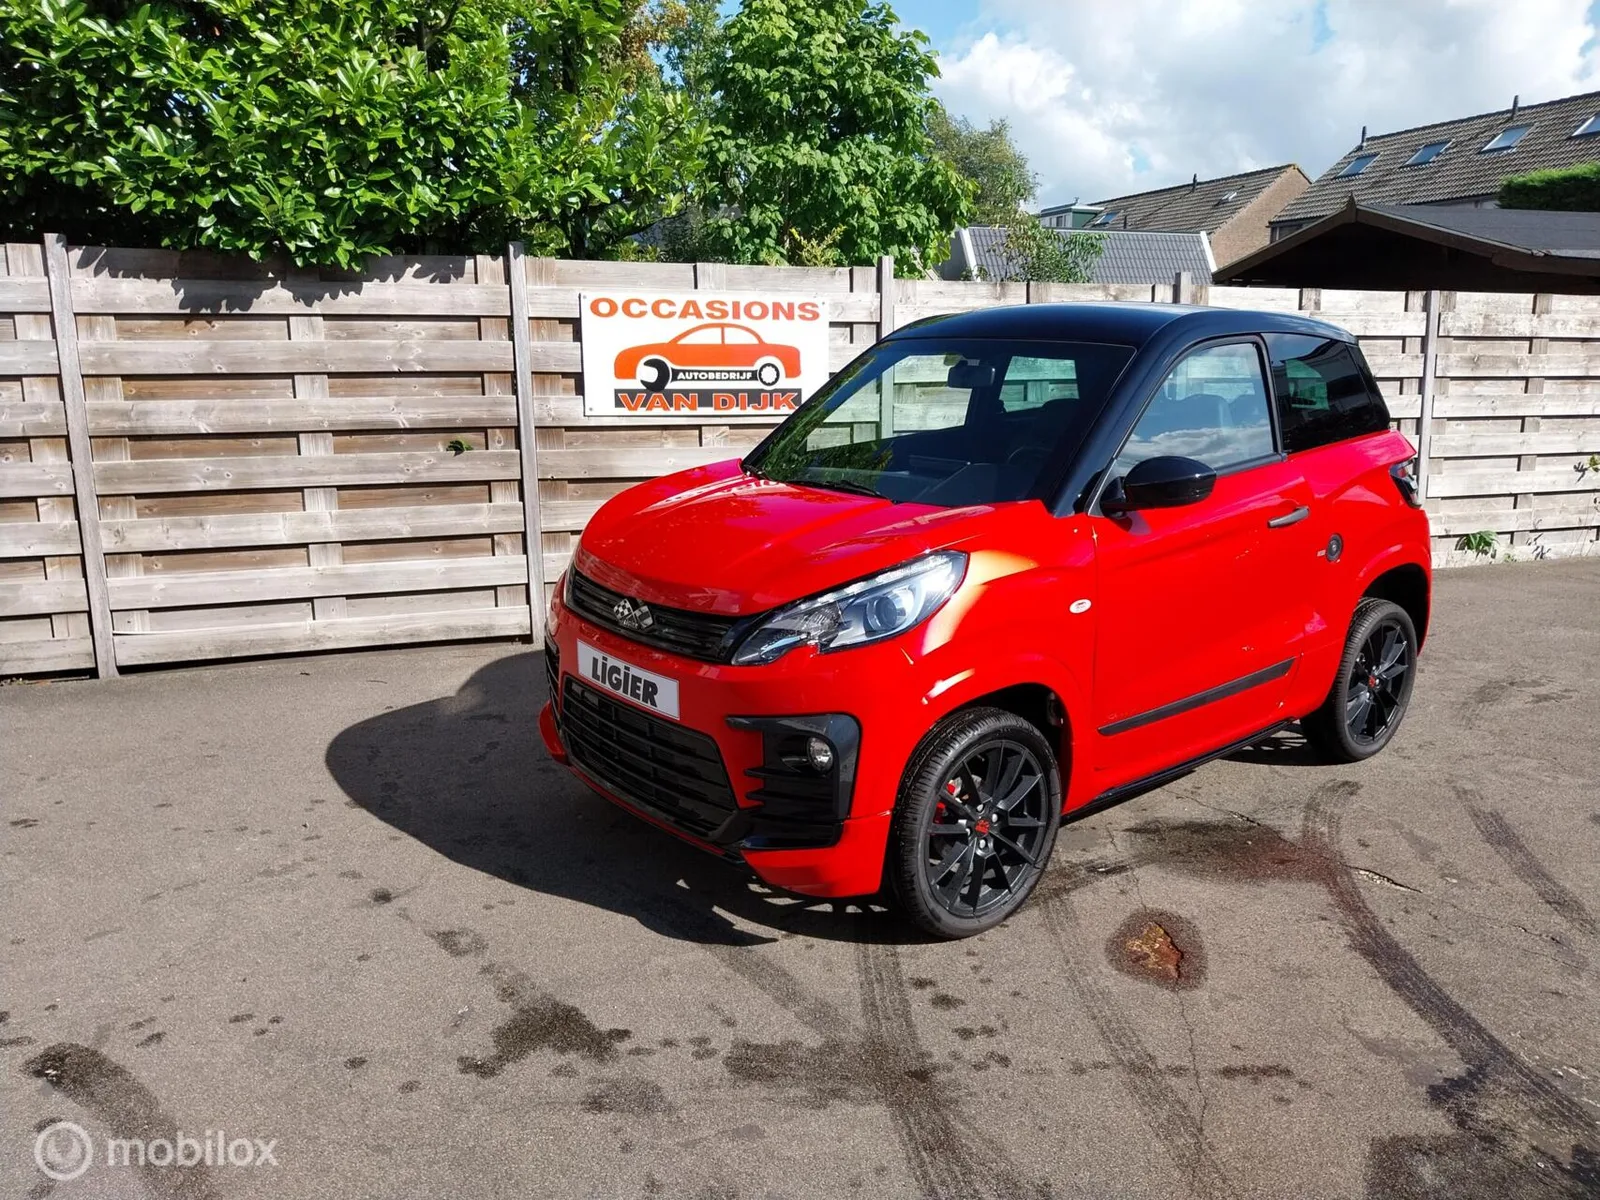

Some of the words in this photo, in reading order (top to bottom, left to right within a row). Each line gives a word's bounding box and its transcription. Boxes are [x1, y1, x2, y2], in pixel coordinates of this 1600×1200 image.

[590, 298, 820, 321] OCCASIONS
[676, 369, 753, 380] AUTOBEDRIJF
[618, 392, 699, 412] VAN
[712, 392, 799, 411] DIJK
